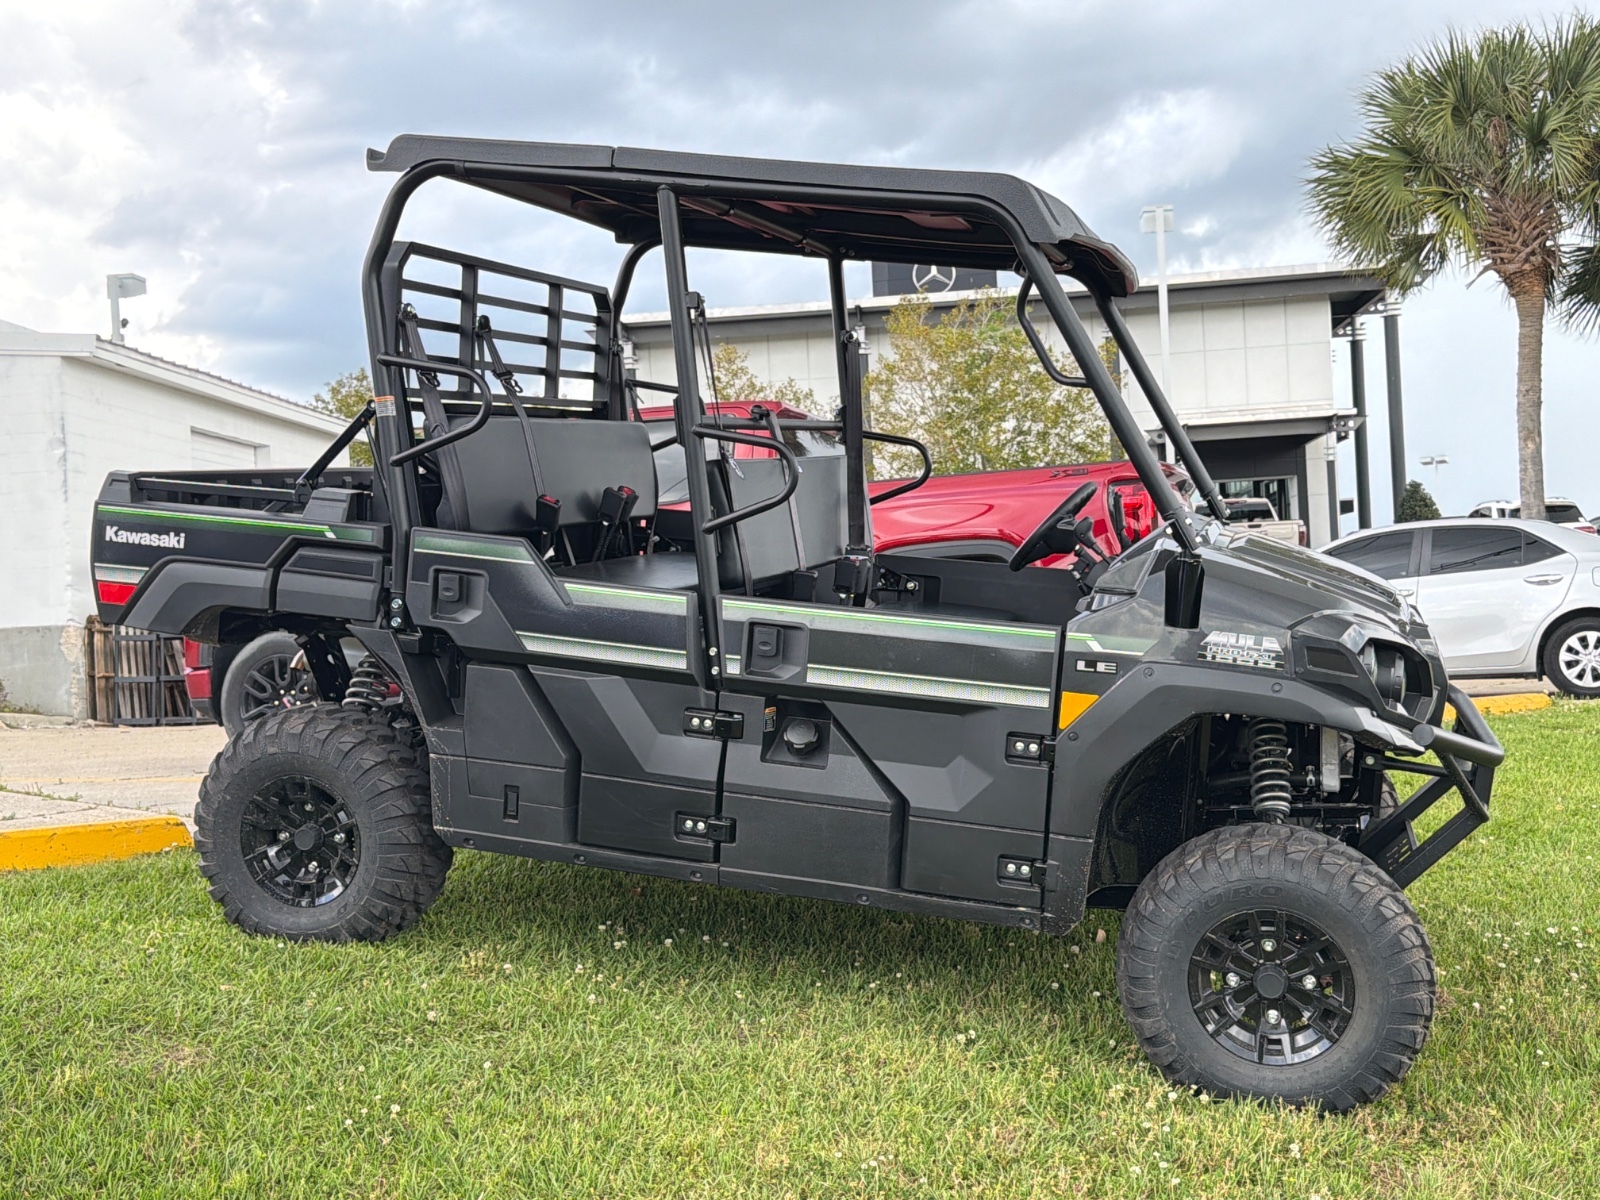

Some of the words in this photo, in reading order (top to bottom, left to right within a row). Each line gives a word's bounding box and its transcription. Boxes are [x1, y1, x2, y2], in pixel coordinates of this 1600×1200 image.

[105, 525, 185, 549] Kawasaki
[1200, 631, 1284, 655] MULE
[1076, 660, 1117, 673] LE
